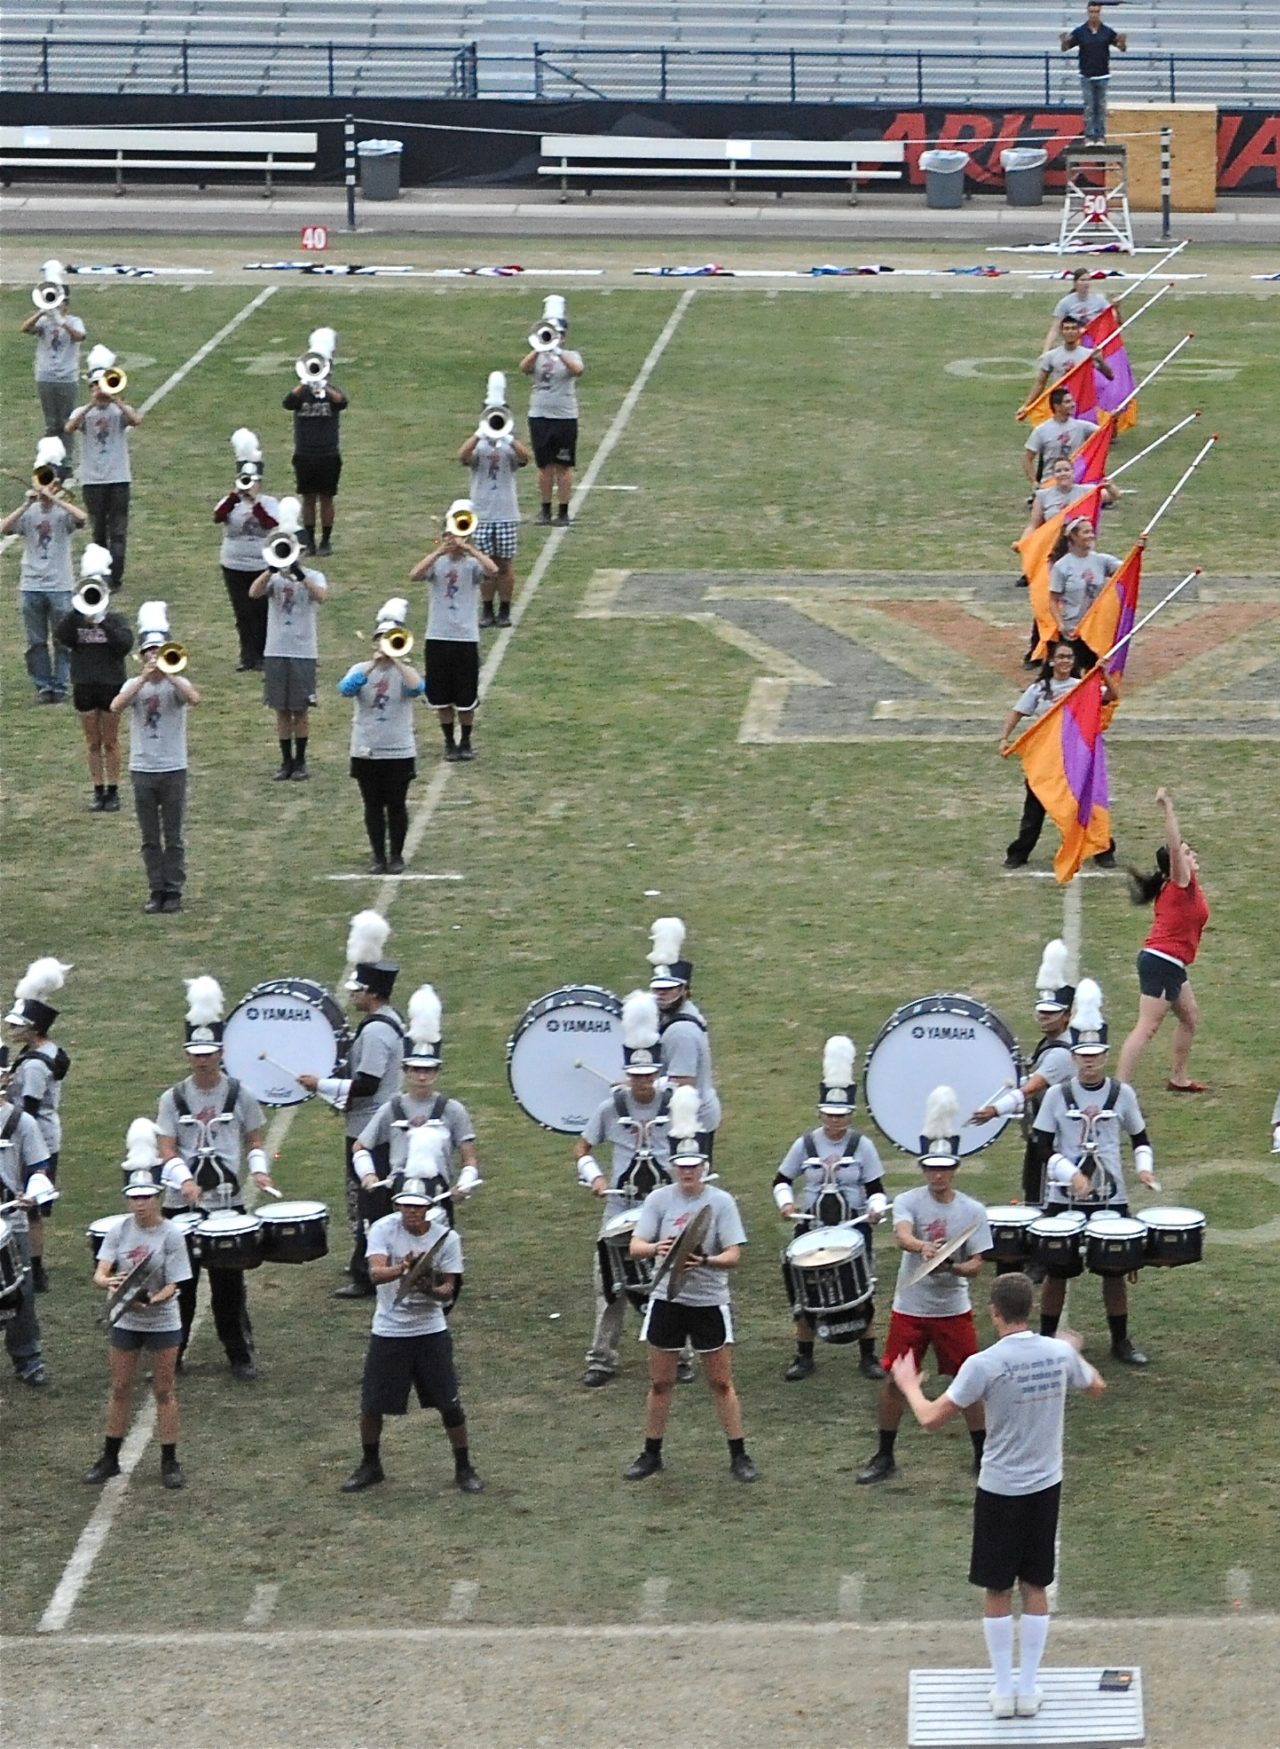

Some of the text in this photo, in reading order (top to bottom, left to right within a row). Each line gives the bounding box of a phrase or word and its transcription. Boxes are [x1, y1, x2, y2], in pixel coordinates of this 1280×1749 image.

[1084, 195, 1106, 214] 50
[303, 228, 327, 249] 40
[262, 1008, 311, 1021] YAMAHA
[562, 1020, 611, 1032] YAMAHA
[927, 1027, 976, 1040] YAMAHA
